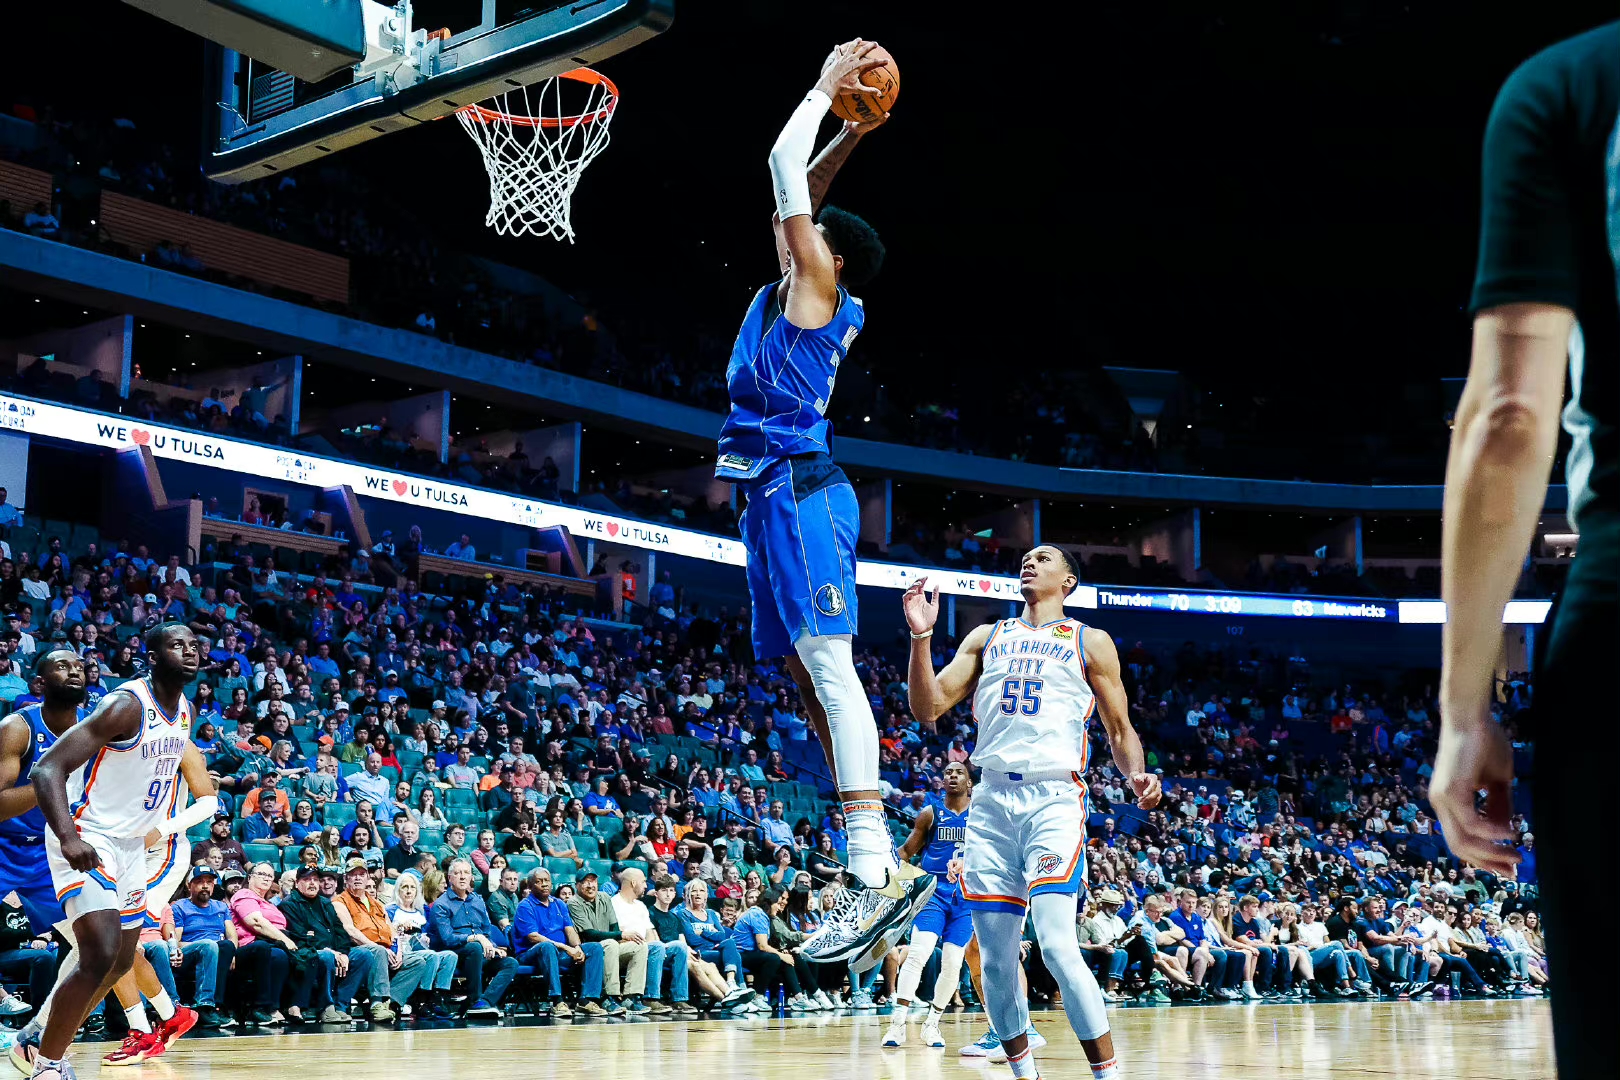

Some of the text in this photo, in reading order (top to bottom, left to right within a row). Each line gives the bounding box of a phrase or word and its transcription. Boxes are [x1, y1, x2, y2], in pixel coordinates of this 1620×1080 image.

[97, 423, 225, 460] WE U TULSA
[365, 475, 469, 507] WE U TULSA
[584, 518, 669, 545] WE U TULSA
[956, 578, 1020, 594] WE U TU
[1098, 591, 1242, 614] Thunder 70 3:09
[1292, 599, 1387, 618] 63 Mavericks
[1226, 625, 1244, 635] 107
[990, 640, 1075, 664] OKLAHOMA
[1007, 658, 1046, 675] CITY
[999, 678, 1044, 716] 55
[148, 708, 156, 721] 6
[36, 733, 45, 742] 6
[141, 737, 186, 760] OKLAHOM
[154, 757, 178, 776] CITY
[142, 778, 172, 811] 97
